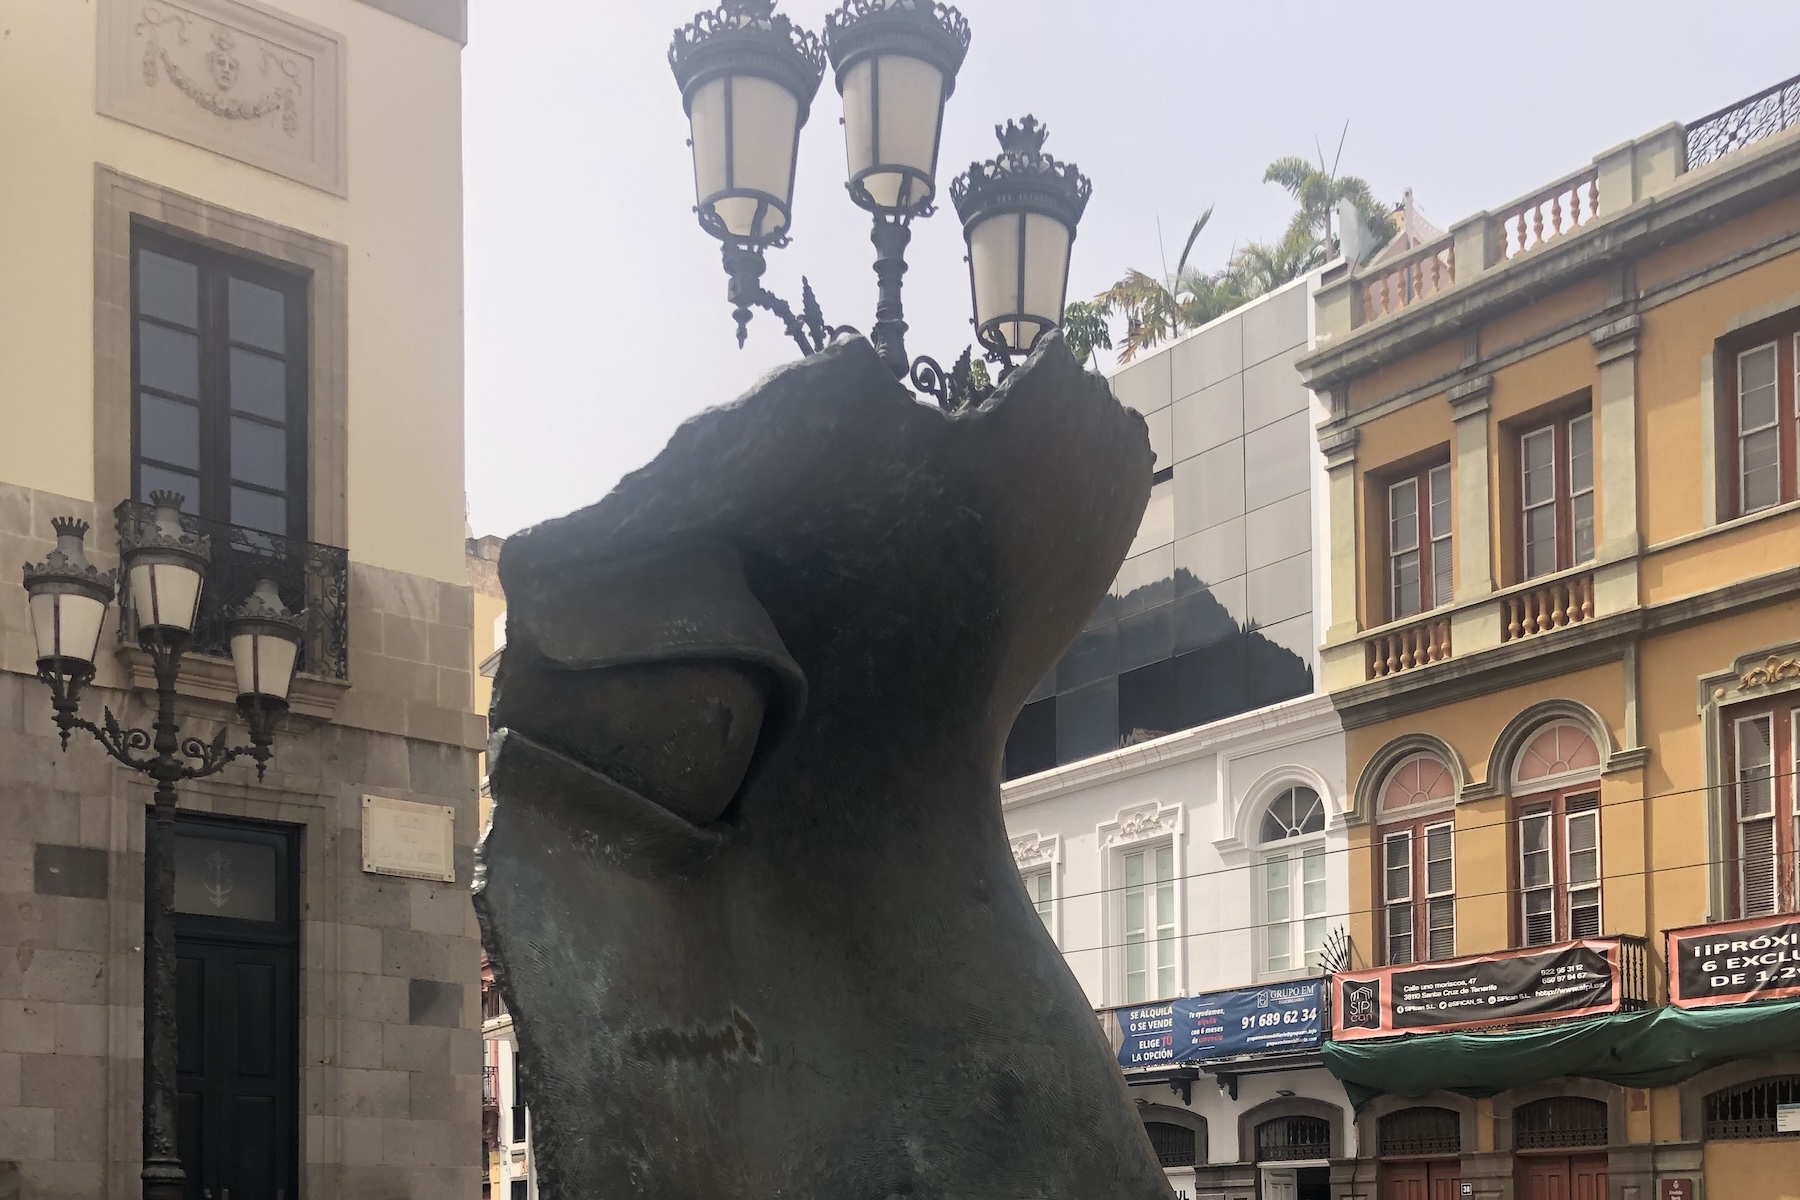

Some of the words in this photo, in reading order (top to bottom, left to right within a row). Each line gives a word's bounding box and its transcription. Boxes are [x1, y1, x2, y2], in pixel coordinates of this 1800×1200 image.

[1702, 960, 1718, 972] 6
[1403, 985, 1420, 993] Calle
[1420, 983, 1434, 991] uno
[1468, 977, 1477, 985] 47
[1556, 975, 1567, 983] 97
[1567, 973, 1577, 981] 94
[1711, 973, 1746, 988] DE
[1270, 987, 1300, 999] GRUPO
[1301, 985, 1315, 995] EM
[1403, 993, 1421, 1001] 38110
[1421, 991, 1442, 999] Santa
[1443, 989, 1459, 997] Cruz
[1470, 984, 1498, 994] Tenerife
[1130, 1011, 1139, 1020] SE
[1140, 1006, 1173, 1019] ALQUILA
[1195, 1008, 1225, 1019] ayudamos,
[1350, 1001, 1373, 1015] SIPI
[1130, 1023, 1136, 1032] O
[1137, 1021, 1147, 1031] SE
[1147, 1018, 1173, 1030] VENDE
[1241, 1016, 1256, 1029] 91
[1258, 1013, 1281, 1027] 689
[1283, 1010, 1299, 1024] 62
[1300, 1007, 1317, 1022] 34
[1205, 1026, 1224, 1034] meses
[1139, 1039, 1160, 1050] ELIGE
[1160, 1033, 1173, 1047] TÚ
[1131, 1053, 1142, 1062] LA
[1143, 1048, 1173, 1061] OPCIÓN
[1463, 1185, 1471, 1193] 38
